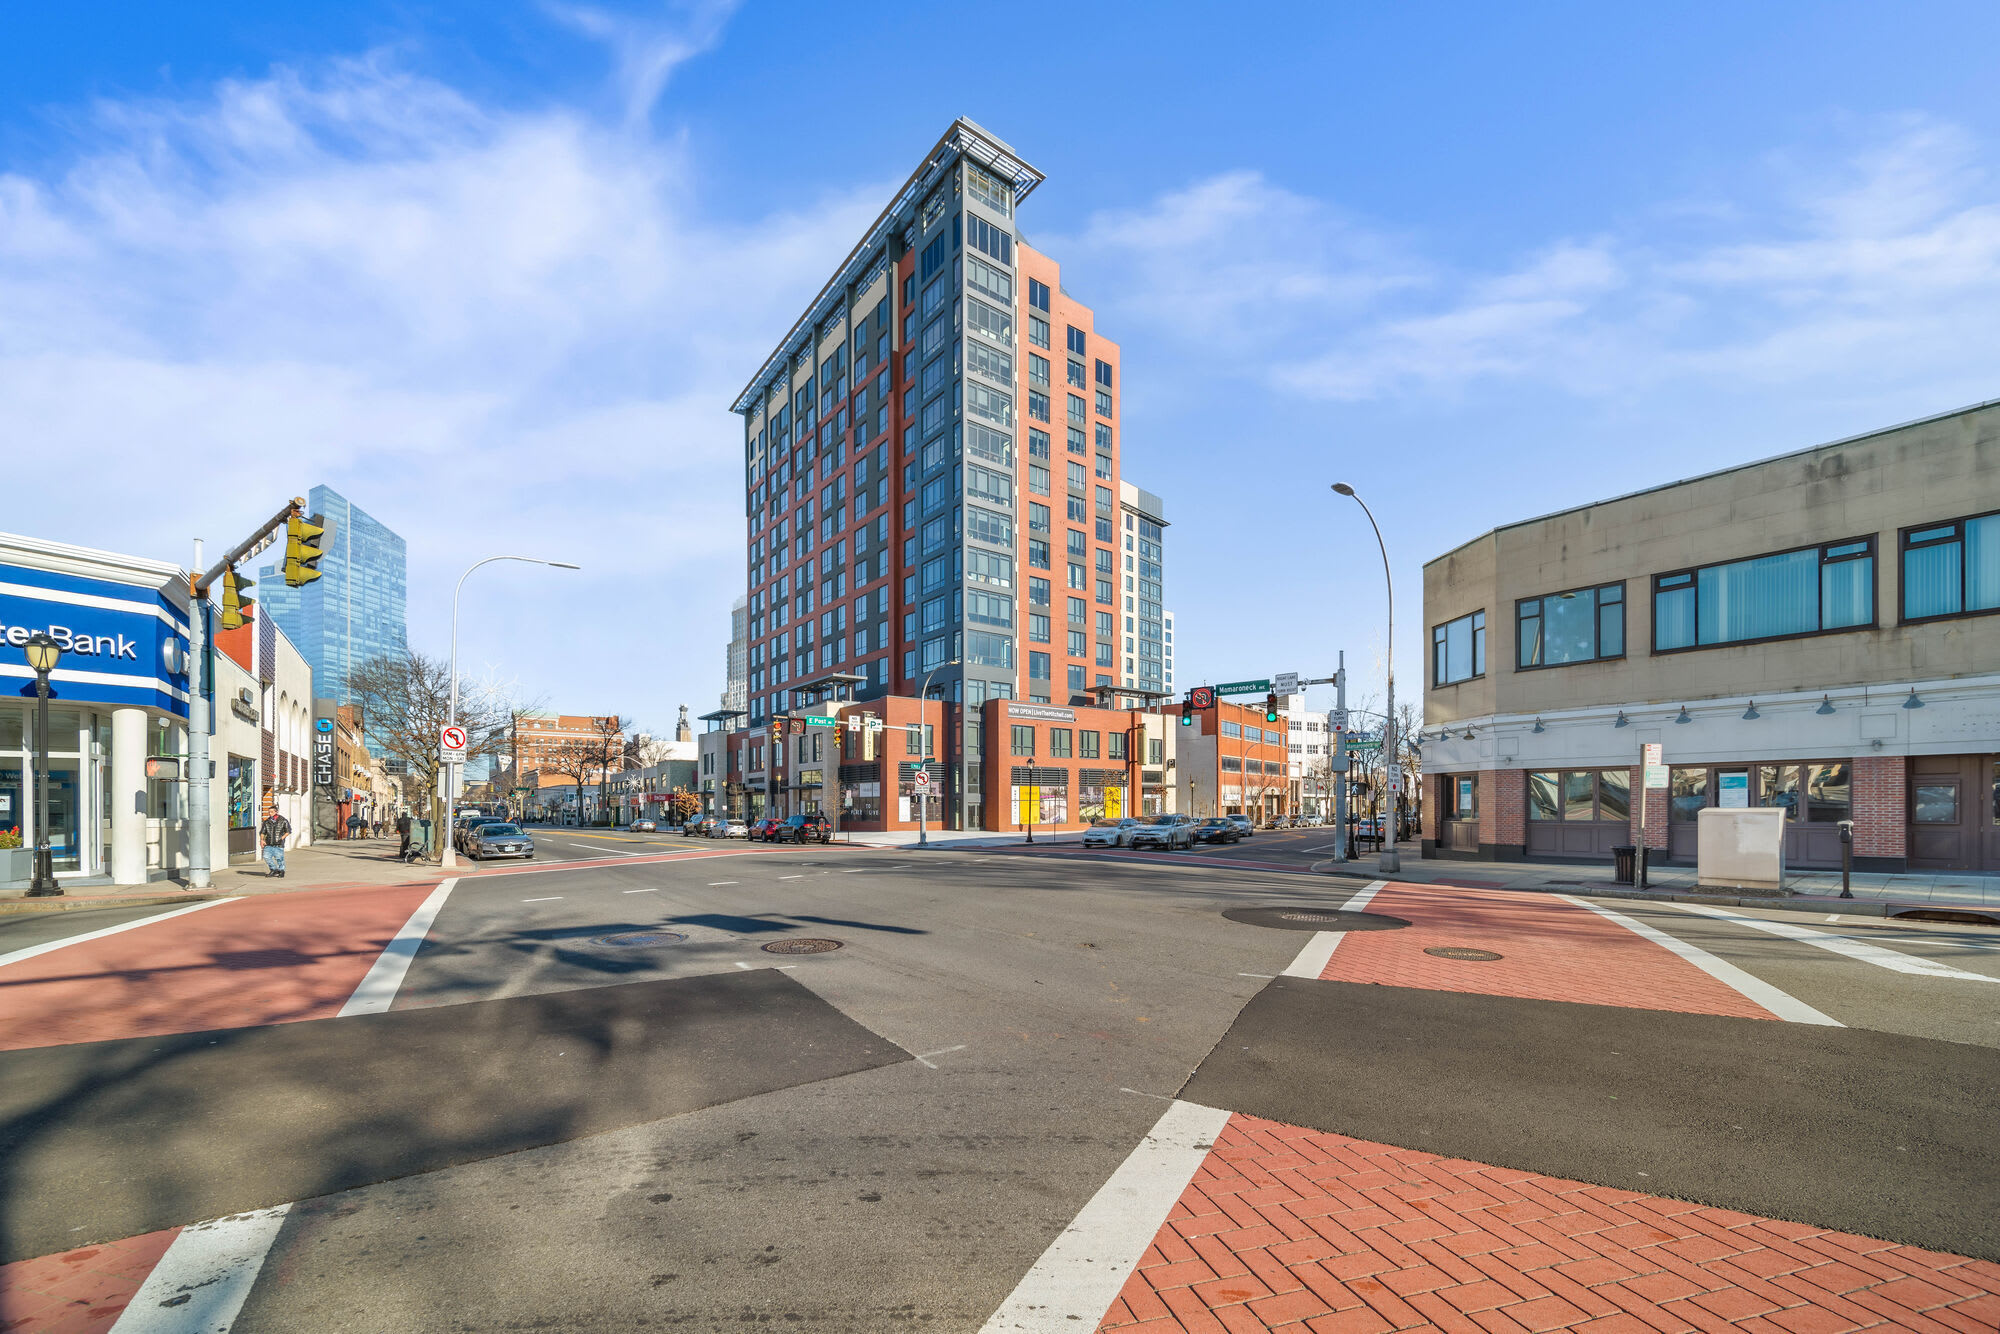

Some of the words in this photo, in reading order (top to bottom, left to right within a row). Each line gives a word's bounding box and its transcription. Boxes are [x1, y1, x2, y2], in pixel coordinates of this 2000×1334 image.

[1219, 684, 1257, 693] Mamaroneck
[870, 721, 877, 729] P
[318, 735, 332, 785] CHASE
